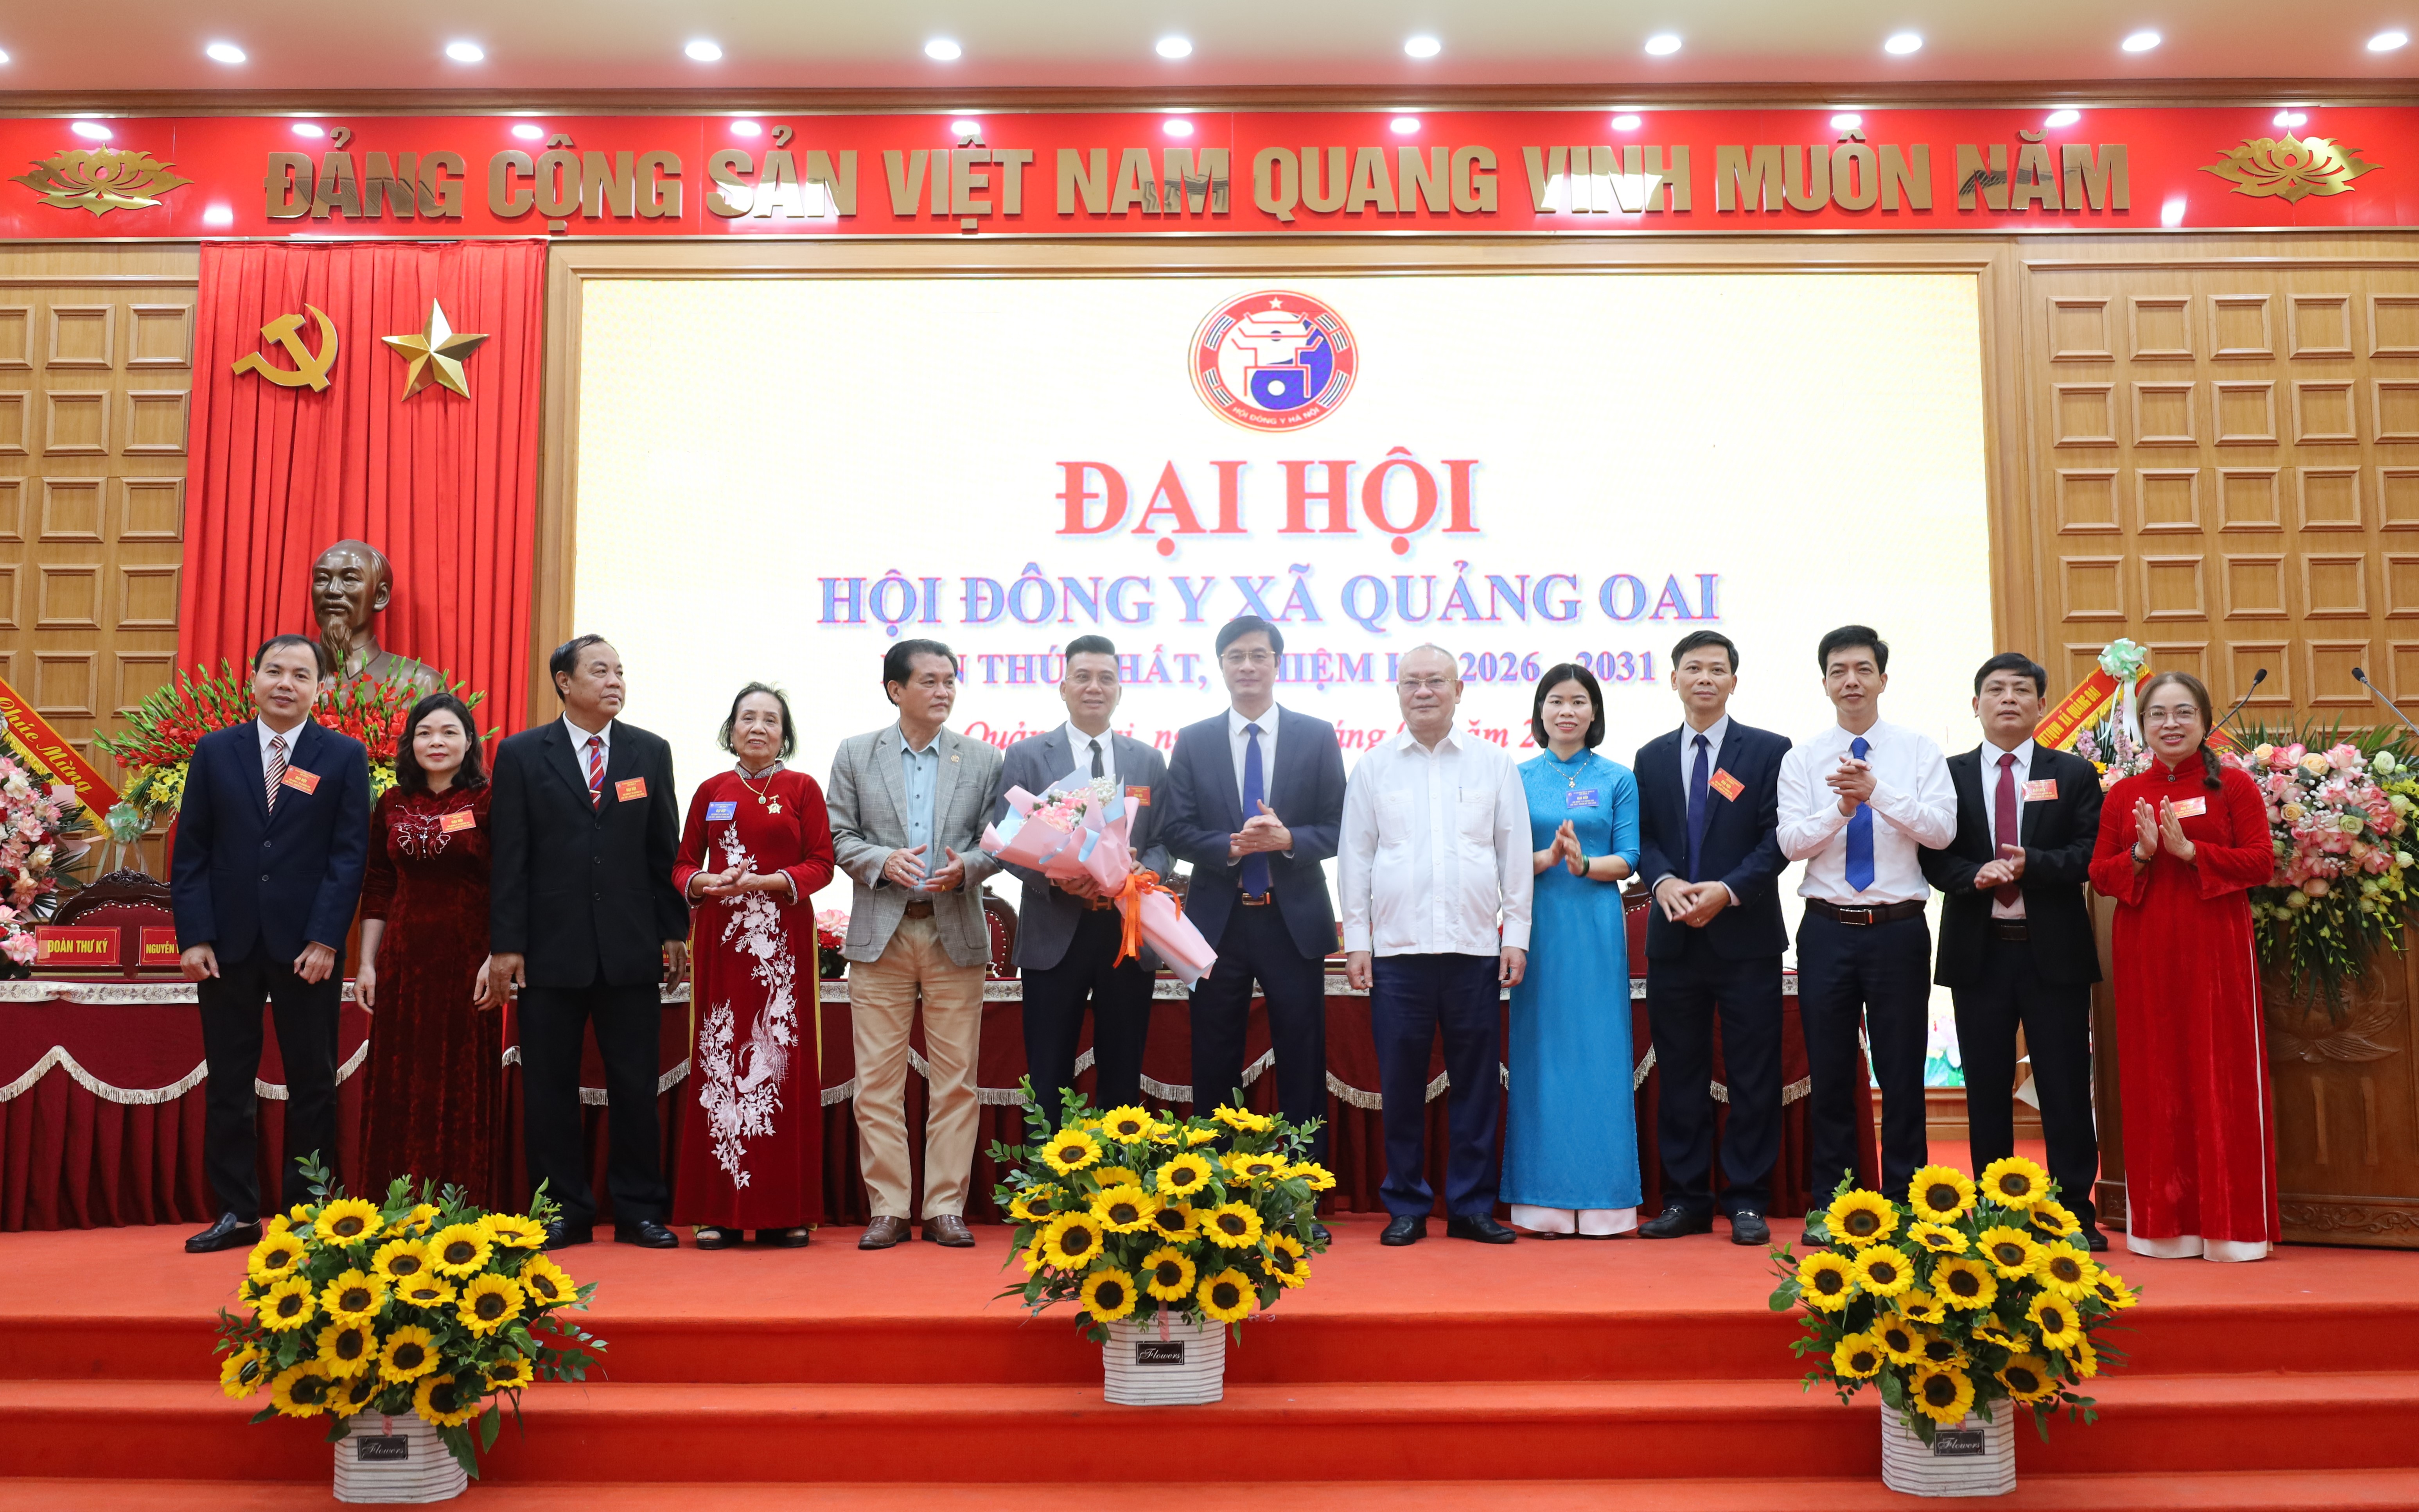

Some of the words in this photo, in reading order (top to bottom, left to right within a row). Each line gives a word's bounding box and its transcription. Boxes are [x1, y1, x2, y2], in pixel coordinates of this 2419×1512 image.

[264, 127, 465, 218] ĐẢNG
[487, 133, 684, 232] CỘNG
[707, 125, 857, 220] SẢN
[881, 134, 1033, 231] VIỆT
[1056, 148, 1230, 217] NAM
[1253, 146, 1498, 222] QUANG
[1522, 145, 1692, 214] VINH
[1714, 130, 1933, 212] MUÔN
[1956, 129, 2130, 210] NĂM
[1055, 460, 1247, 557] ĐẠI
[1277, 446, 1480, 555] HỘI
[817, 570, 943, 637] HỘI
[960, 562, 1156, 624] ĐÔNG
[1170, 575, 1227, 622] Y
[1228, 565, 1324, 622] XÃ
[1341, 561, 1581, 633] QUẢNG
[1599, 574, 1720, 621] OAI
[1115, 644, 1207, 690] HẤT,
[1458, 651, 1540, 682] 2026
[2066, 694, 2092, 719] QUẢNG
[2084, 685, 2102, 702] OAI
[0, 697, 39, 743] Chúc
[36, 744, 93, 794] Mừng
[48, 937, 74, 953] ĐOÀN
[76, 939, 95, 953] THƯ
[96, 938, 108, 953] KÝ
[145, 940, 175, 954] NGUYỄN
[1140, 1348, 1180, 1359] Flowers
[361, 1443, 404, 1454] Flowers
[1938, 1437, 1980, 1449] Flowers
